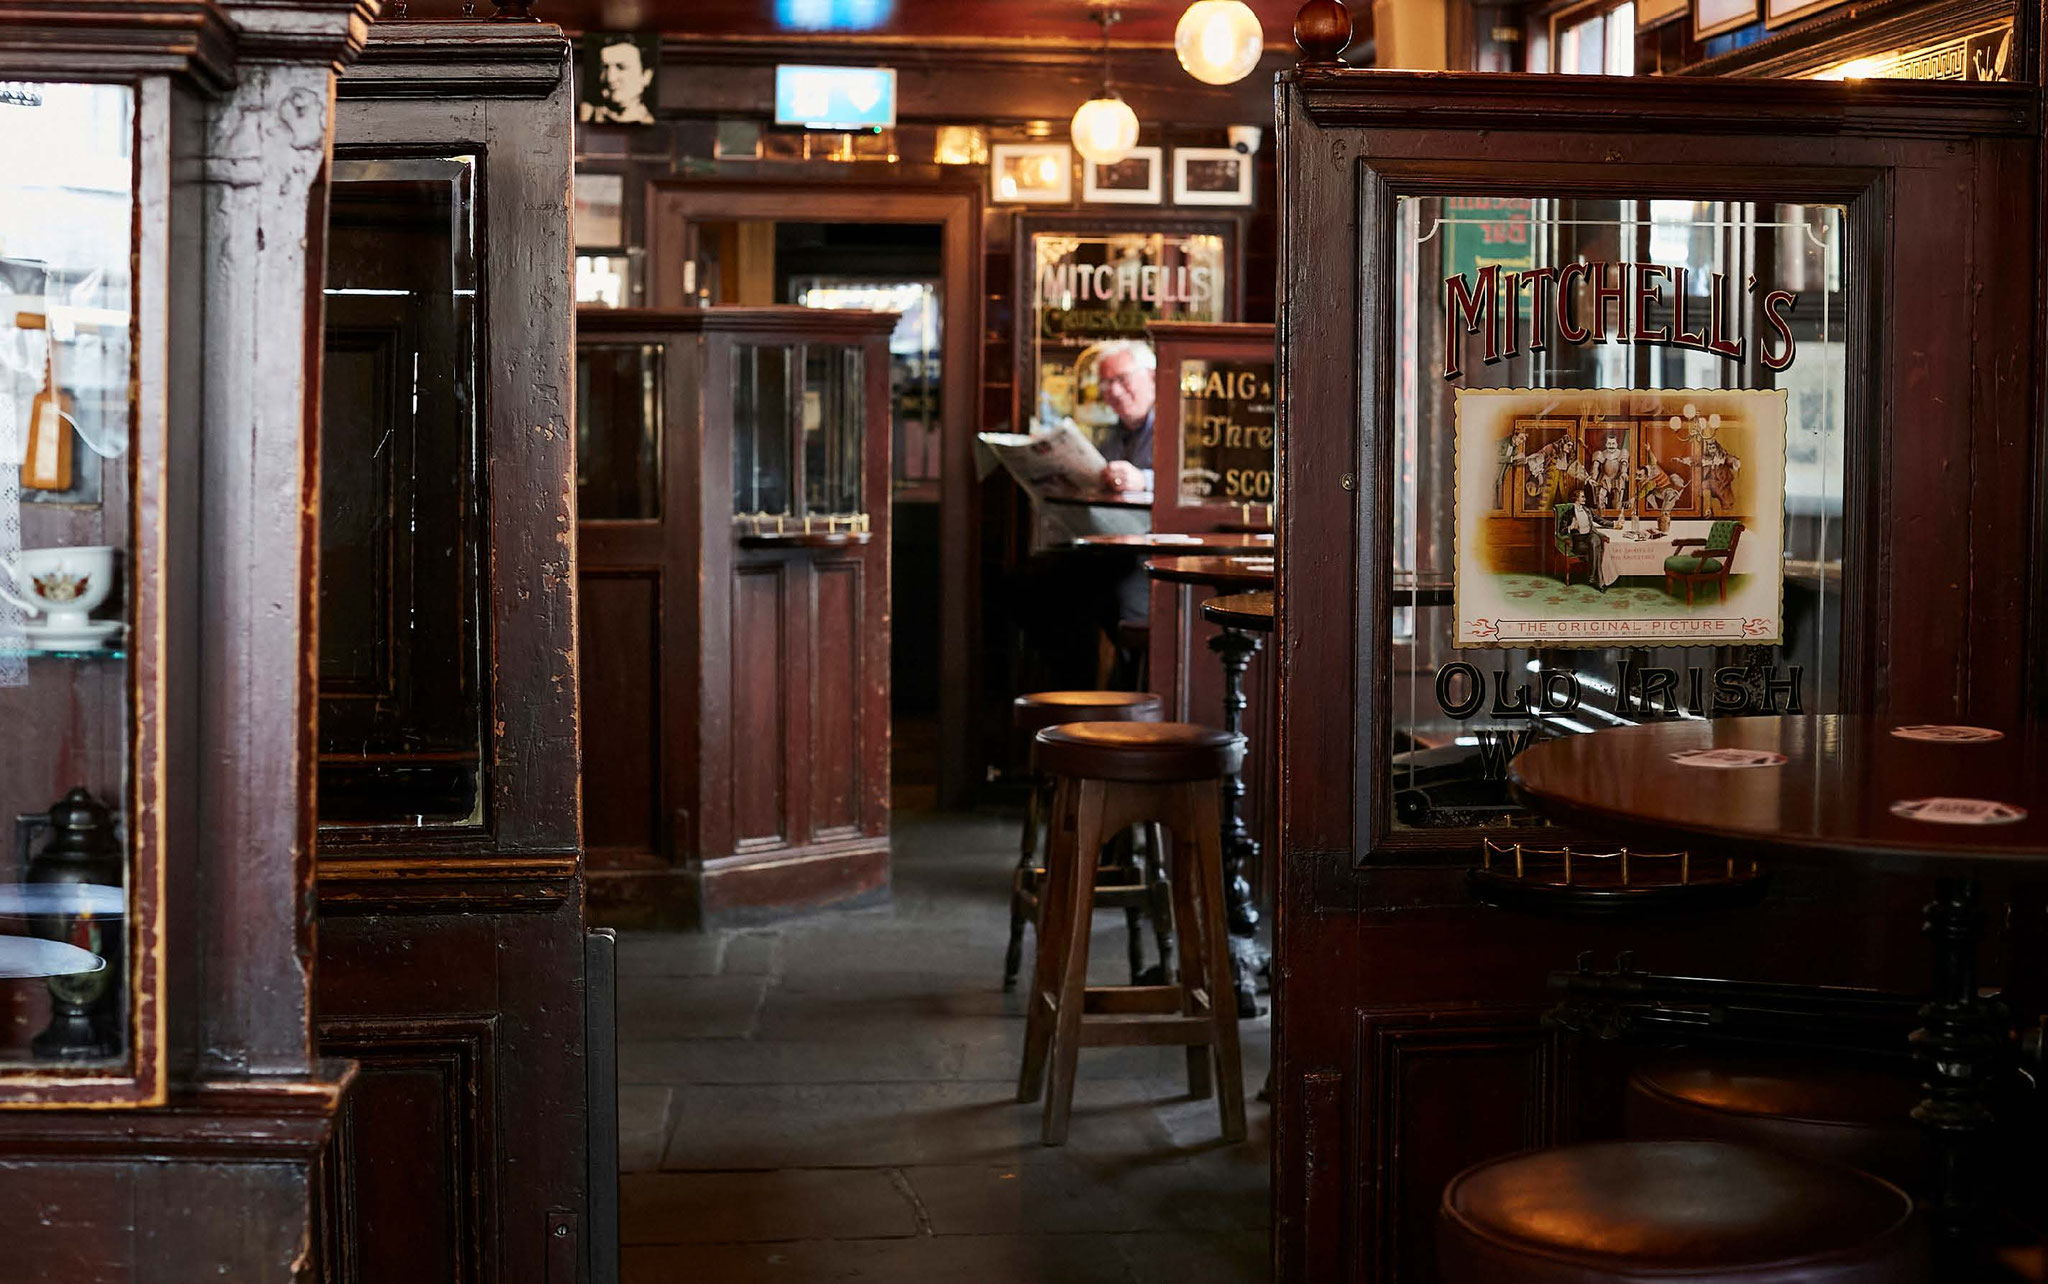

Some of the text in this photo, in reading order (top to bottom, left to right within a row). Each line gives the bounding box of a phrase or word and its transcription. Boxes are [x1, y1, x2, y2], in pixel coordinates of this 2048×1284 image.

[1444, 261, 1798, 379] MITCHELL'S
[1518, 620, 1726, 632] THE ORIGINAL PICTURE
[1434, 660, 1804, 719] OLD IRISH
